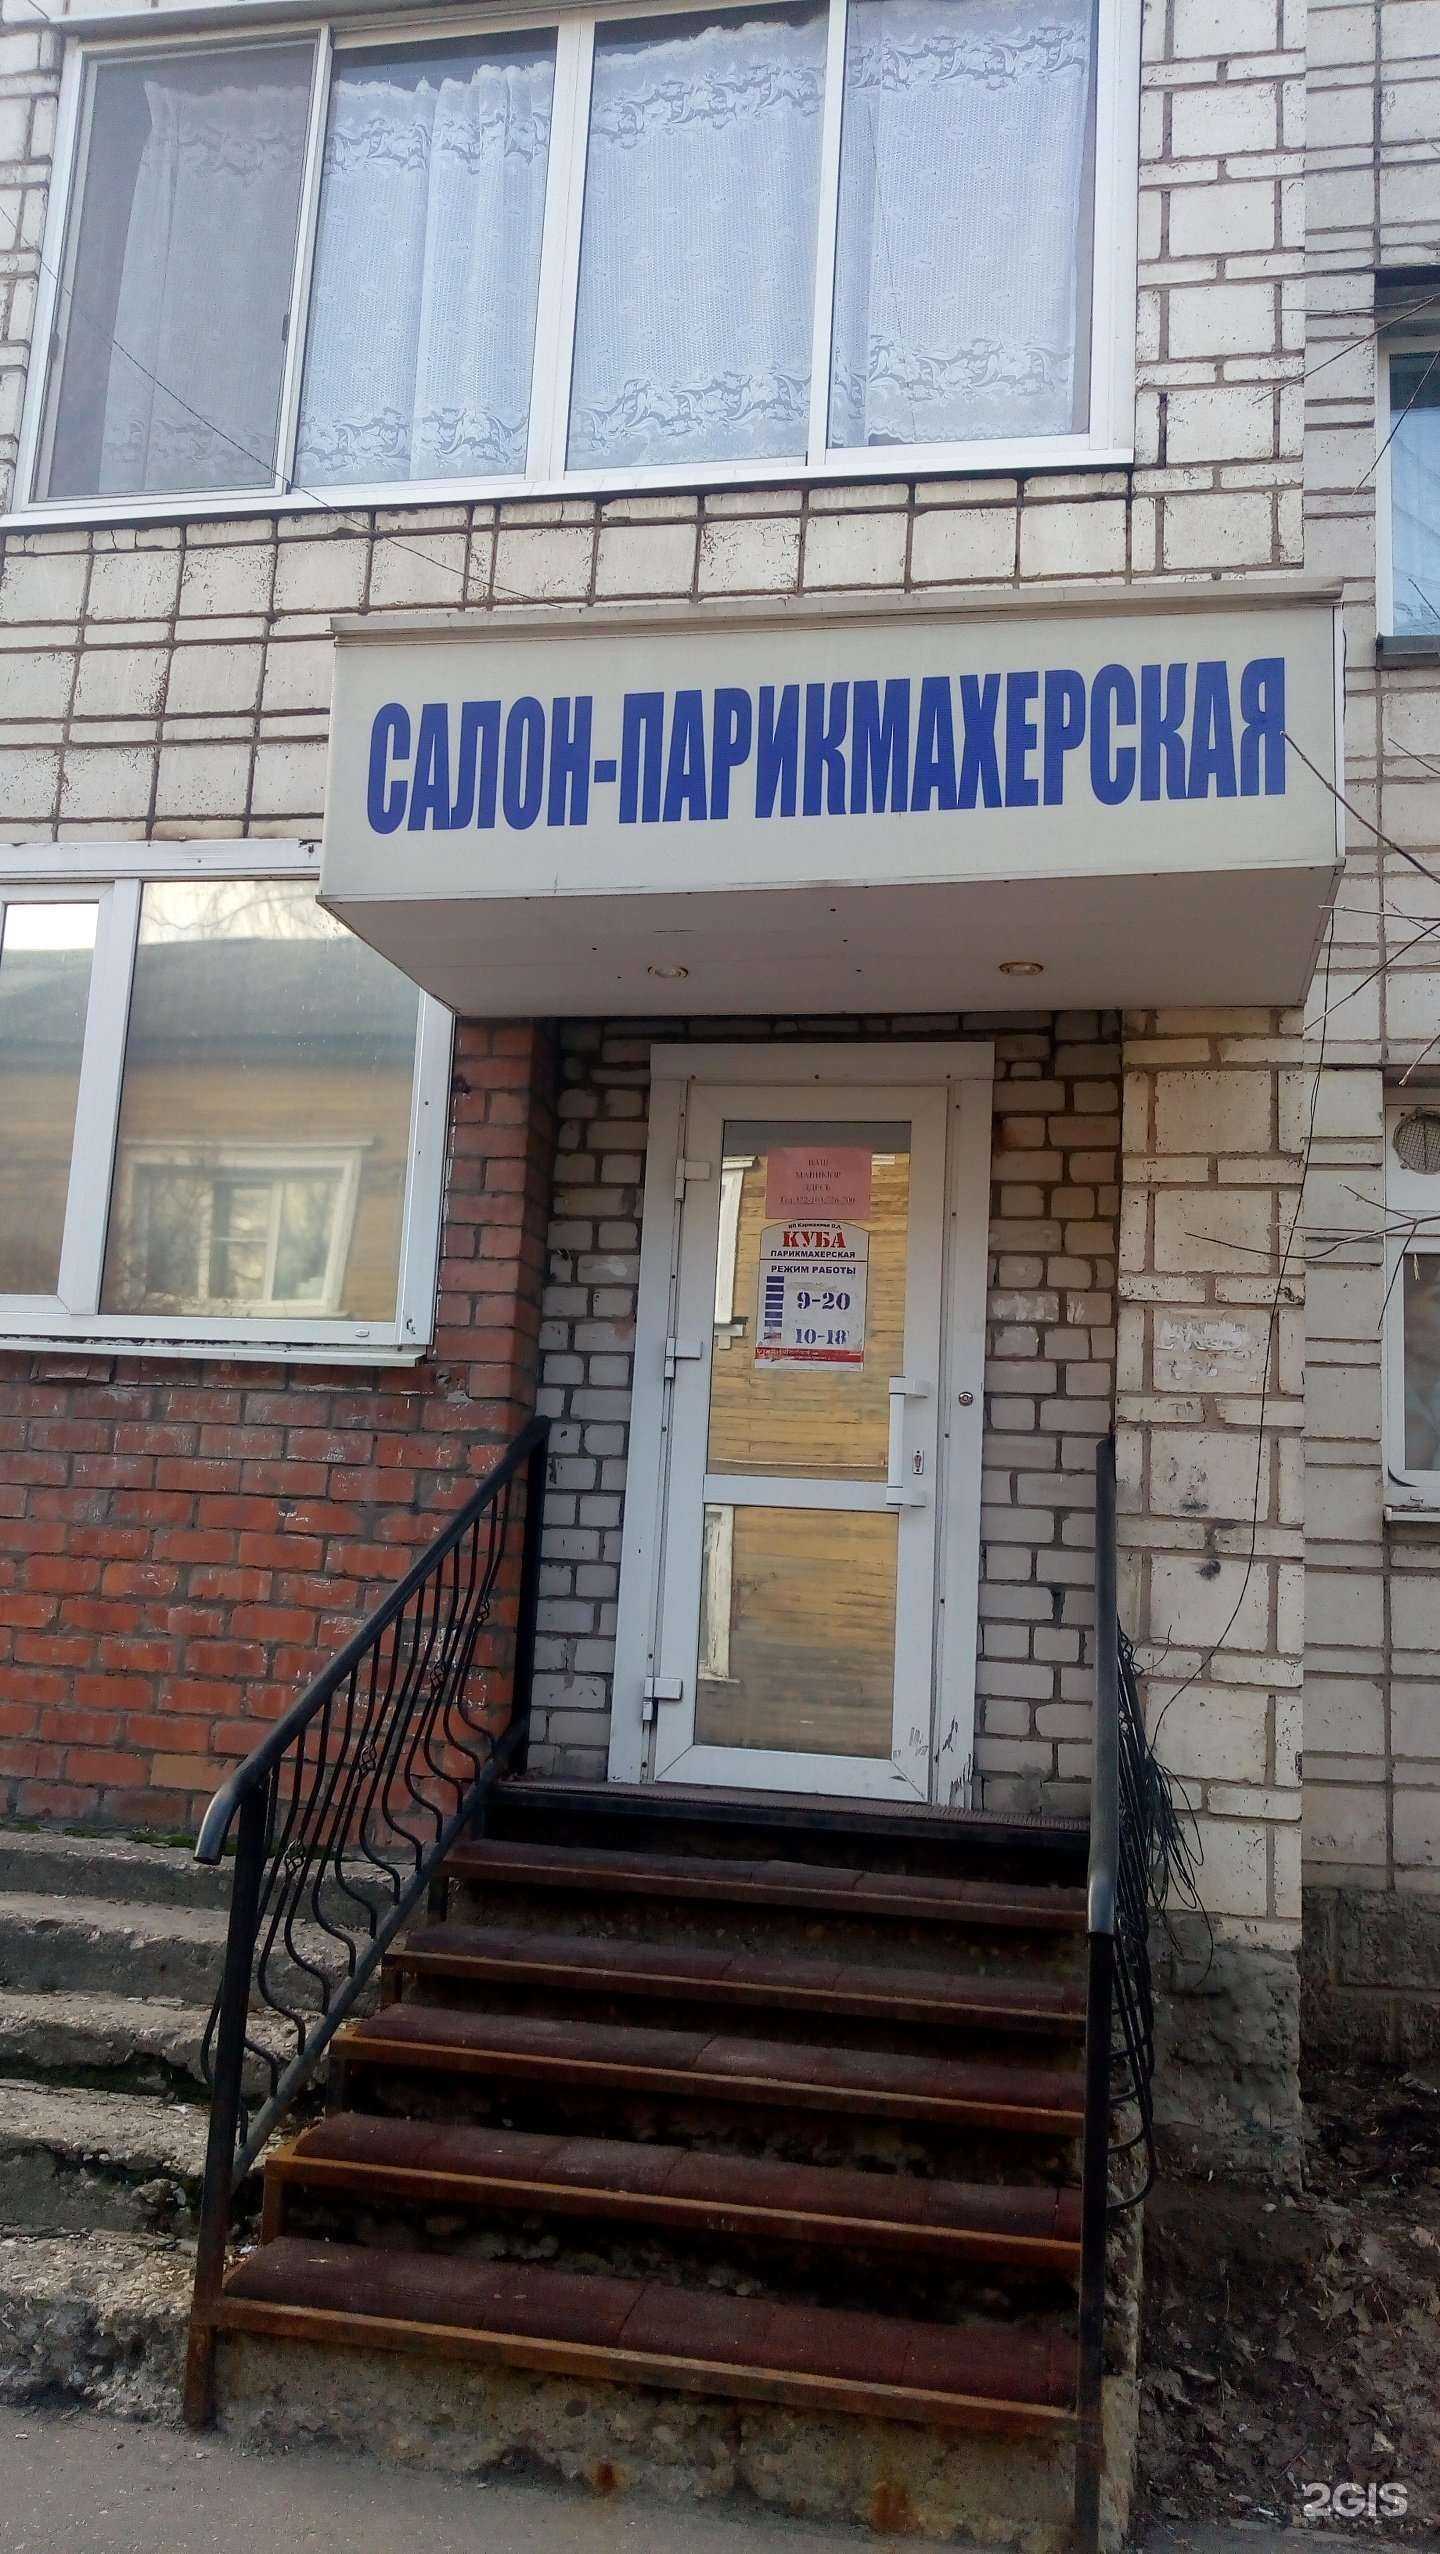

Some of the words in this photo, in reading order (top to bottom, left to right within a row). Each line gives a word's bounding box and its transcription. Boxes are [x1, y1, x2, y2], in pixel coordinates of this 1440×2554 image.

[366, 657, 1286, 834] САЛОН-ПАРИКМАХЕРСКАЯ
[782, 1231, 847, 1248] КУБА
[770, 1250, 856, 1259] ПАРИКМАХЕРСКАЯ
[771, 1265, 809, 1273] РЕЖИМ
[812, 1266, 857, 1275] РАБОТЫ
[797, 1292, 851, 1310] 9-20
[795, 1329, 847, 1345] 10-18
